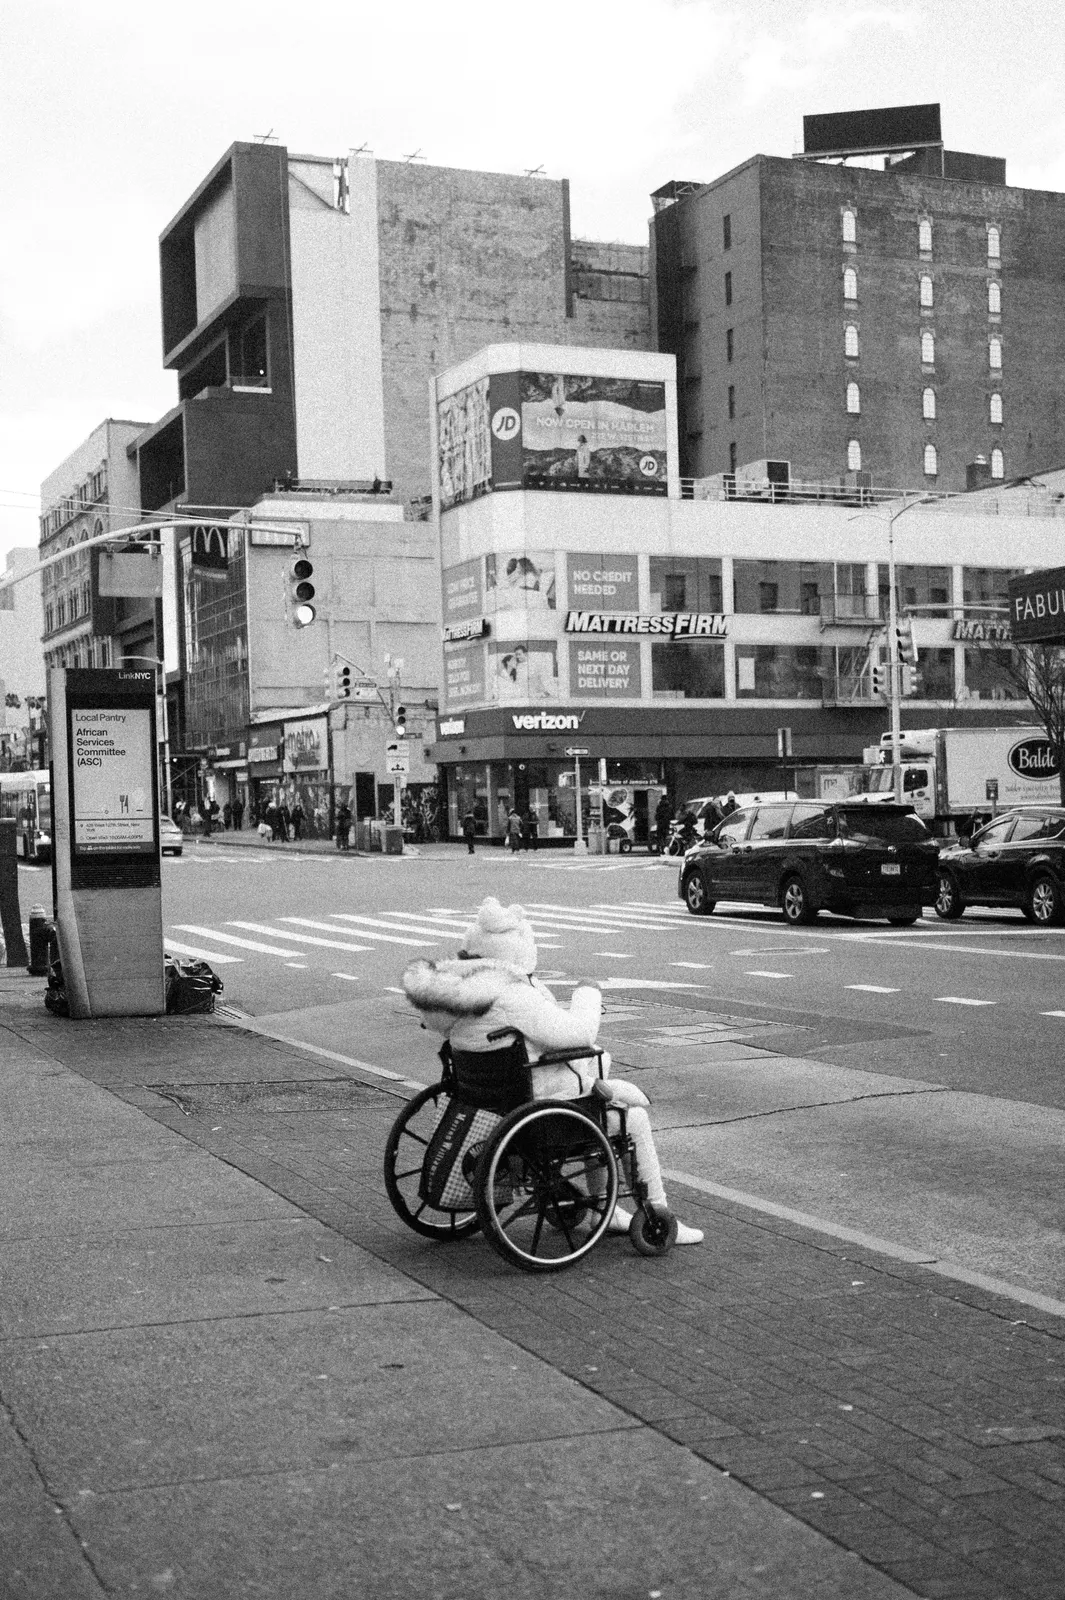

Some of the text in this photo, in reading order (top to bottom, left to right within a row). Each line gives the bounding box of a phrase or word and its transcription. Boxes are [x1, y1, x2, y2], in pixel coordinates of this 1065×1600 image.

[496, 415, 516, 432] JD
[536, 416, 563, 428] NOW
[565, 418, 596, 430] OPEN
[598, 420, 609, 431] IN
[642, 461, 655, 471] JD
[573, 570, 633, 582] NO CREDIT
[573, 584, 617, 595] NEEDED
[577, 650, 628, 661] SAME OR
[577, 663, 630, 675] NEXT DAY
[118, 672, 151, 680] LinkNYC
[578, 677, 630, 689] DELIVERY
[75, 713, 126, 723] Local Pantry
[512, 711, 579, 730] verizon
[76, 728, 108, 736] African
[76, 738, 115, 746] Services
[76, 748, 126, 756] Committee
[77, 757, 102, 767] (ASC)
